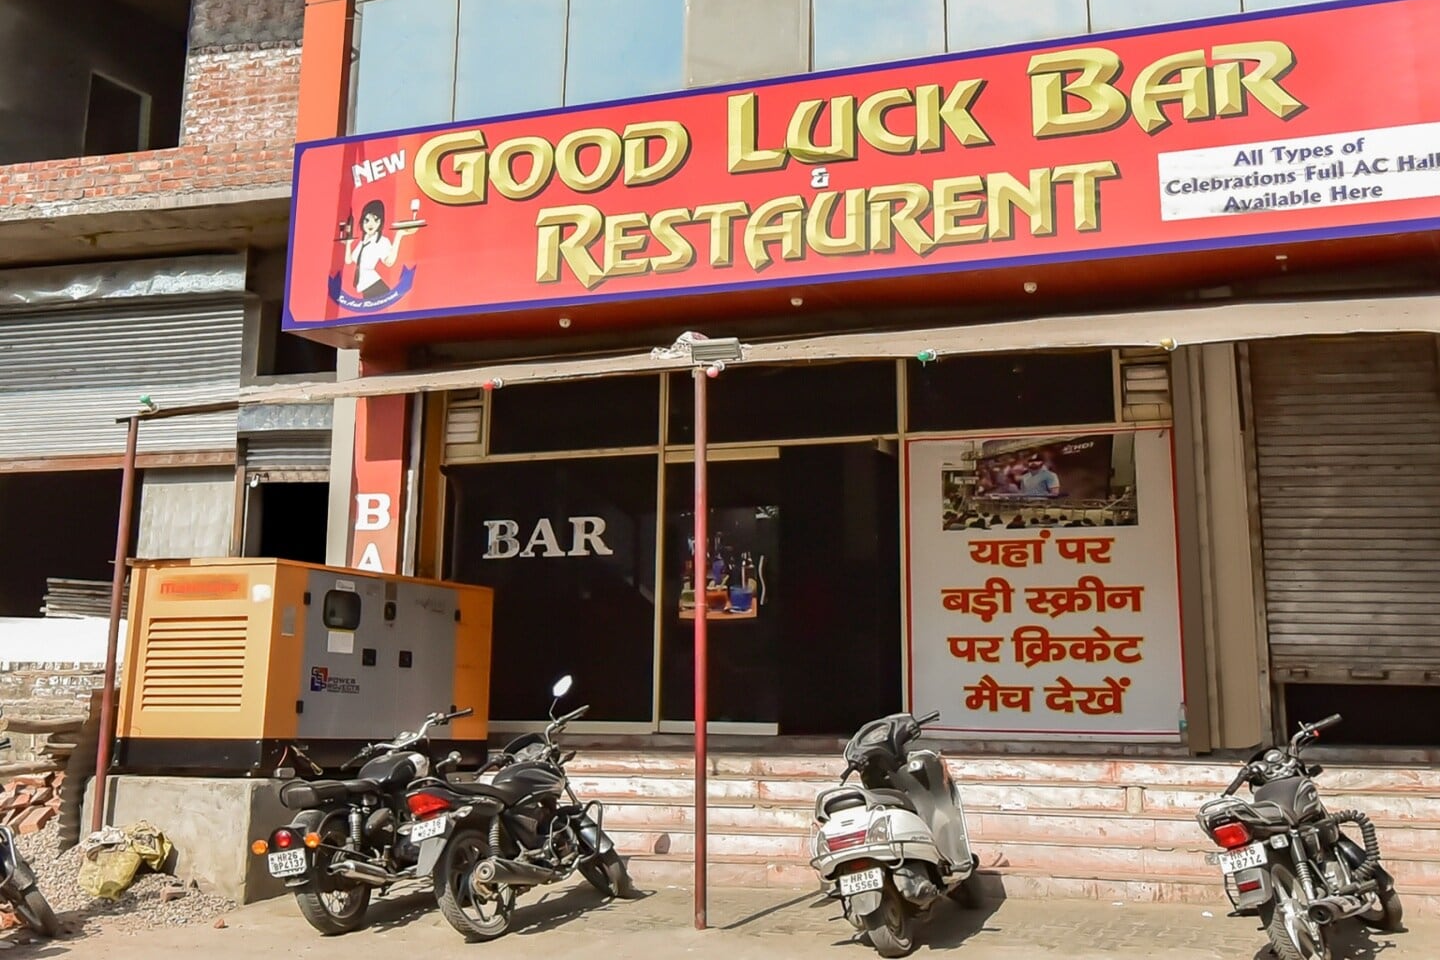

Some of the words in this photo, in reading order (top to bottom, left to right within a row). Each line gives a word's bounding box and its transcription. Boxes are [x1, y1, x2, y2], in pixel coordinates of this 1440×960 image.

[414, 122, 690, 205] GOOD
[727, 78, 993, 173] LUCK
[1026, 40, 1309, 140] BAR
[352, 149, 406, 188] NEW
[1233, 149, 1263, 167] All
[1272, 145, 1334, 165] Types
[1342, 137, 1365, 155] of
[1165, 170, 1297, 196] Celebrations
[1305, 160, 1345, 182] Full
[1352, 157, 1390, 177] AC
[1223, 189, 1322, 213] Available
[1330, 184, 1384, 202] Here
[535, 160, 1119, 291] RESTAURENT
[482, 516, 614, 560] BAR
[968, 529, 1051, 568] यहां
[1055, 537, 1115, 564] पर
[941, 577, 1015, 623] बड़ी
[1024, 575, 1145, 619] स्क्रीन
[947, 636, 1004, 664] पर
[1011, 625, 1144, 669] क्रिकेट
[964, 674, 1035, 713] मैच
[1044, 676, 1131, 715] देखें
